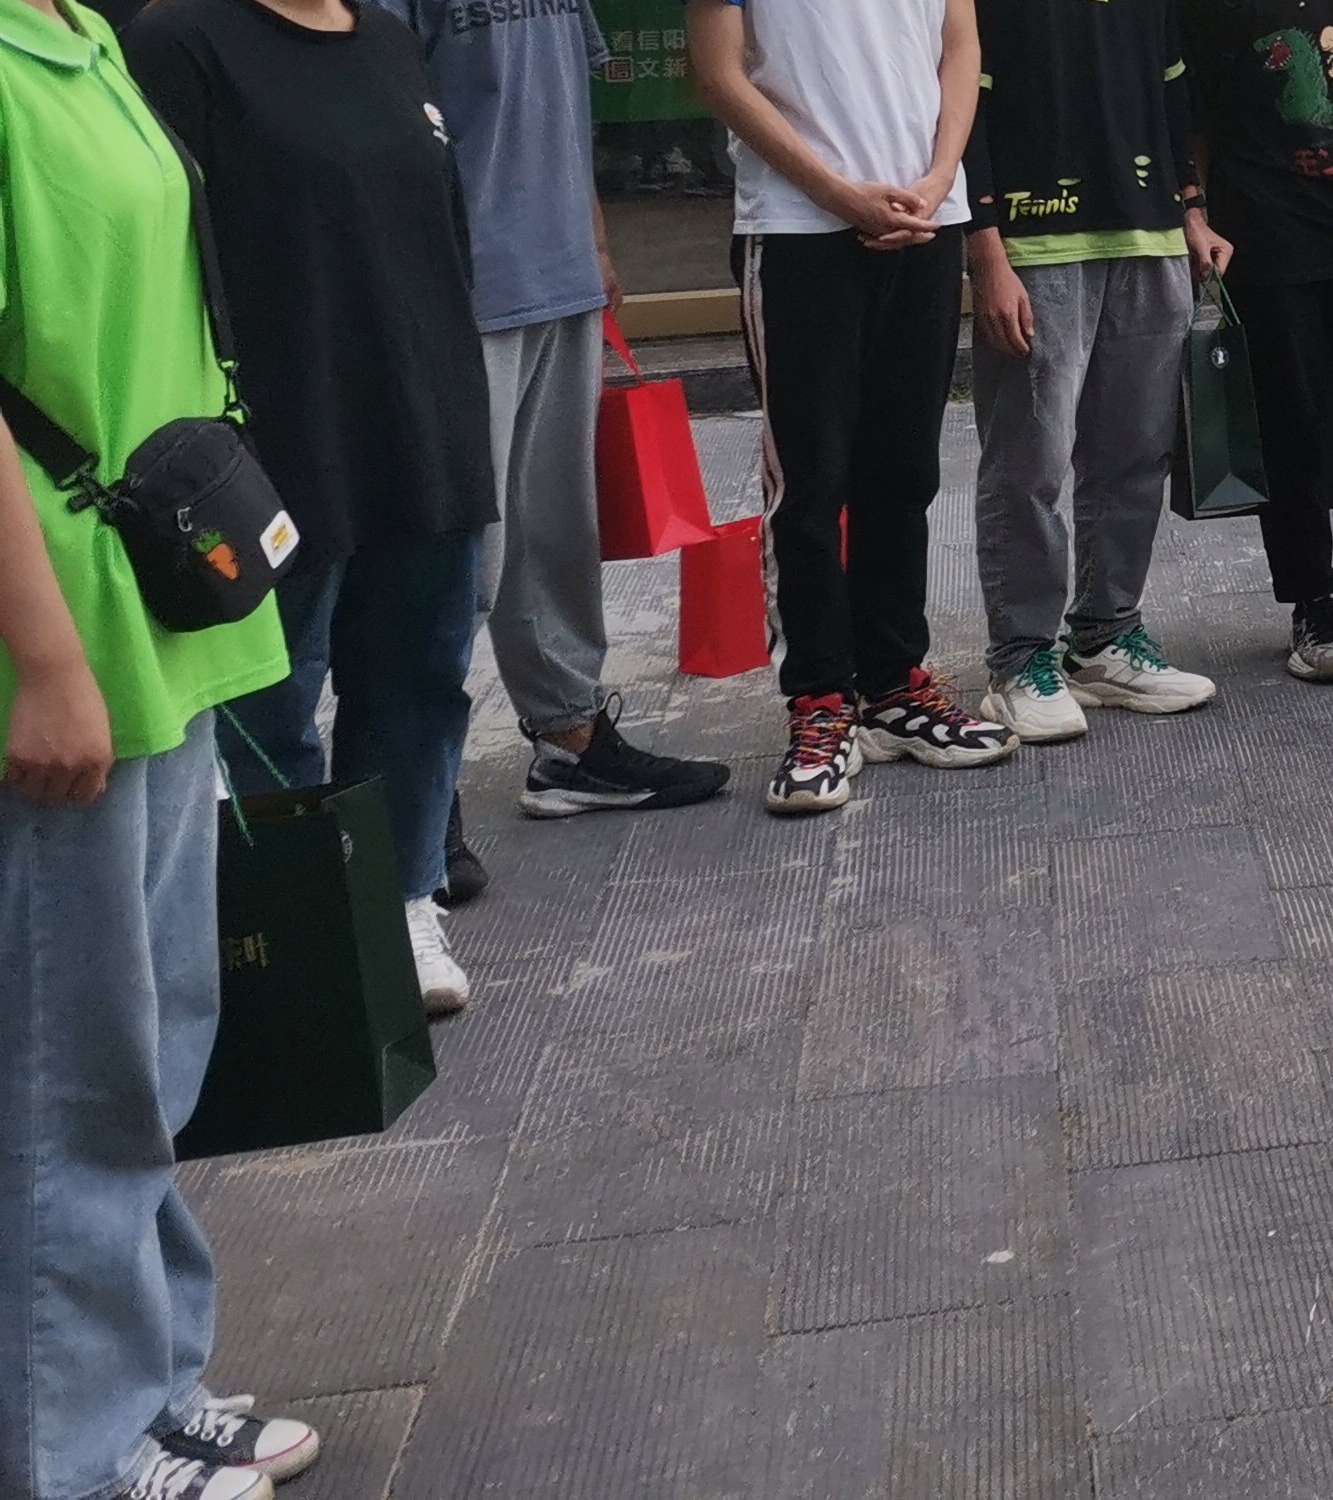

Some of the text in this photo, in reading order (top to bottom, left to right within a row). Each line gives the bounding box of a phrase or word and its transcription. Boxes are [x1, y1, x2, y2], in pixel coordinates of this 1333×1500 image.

[602, 28, 686, 52] 看信阳
[1004, 188, 1080, 222] Tennis
